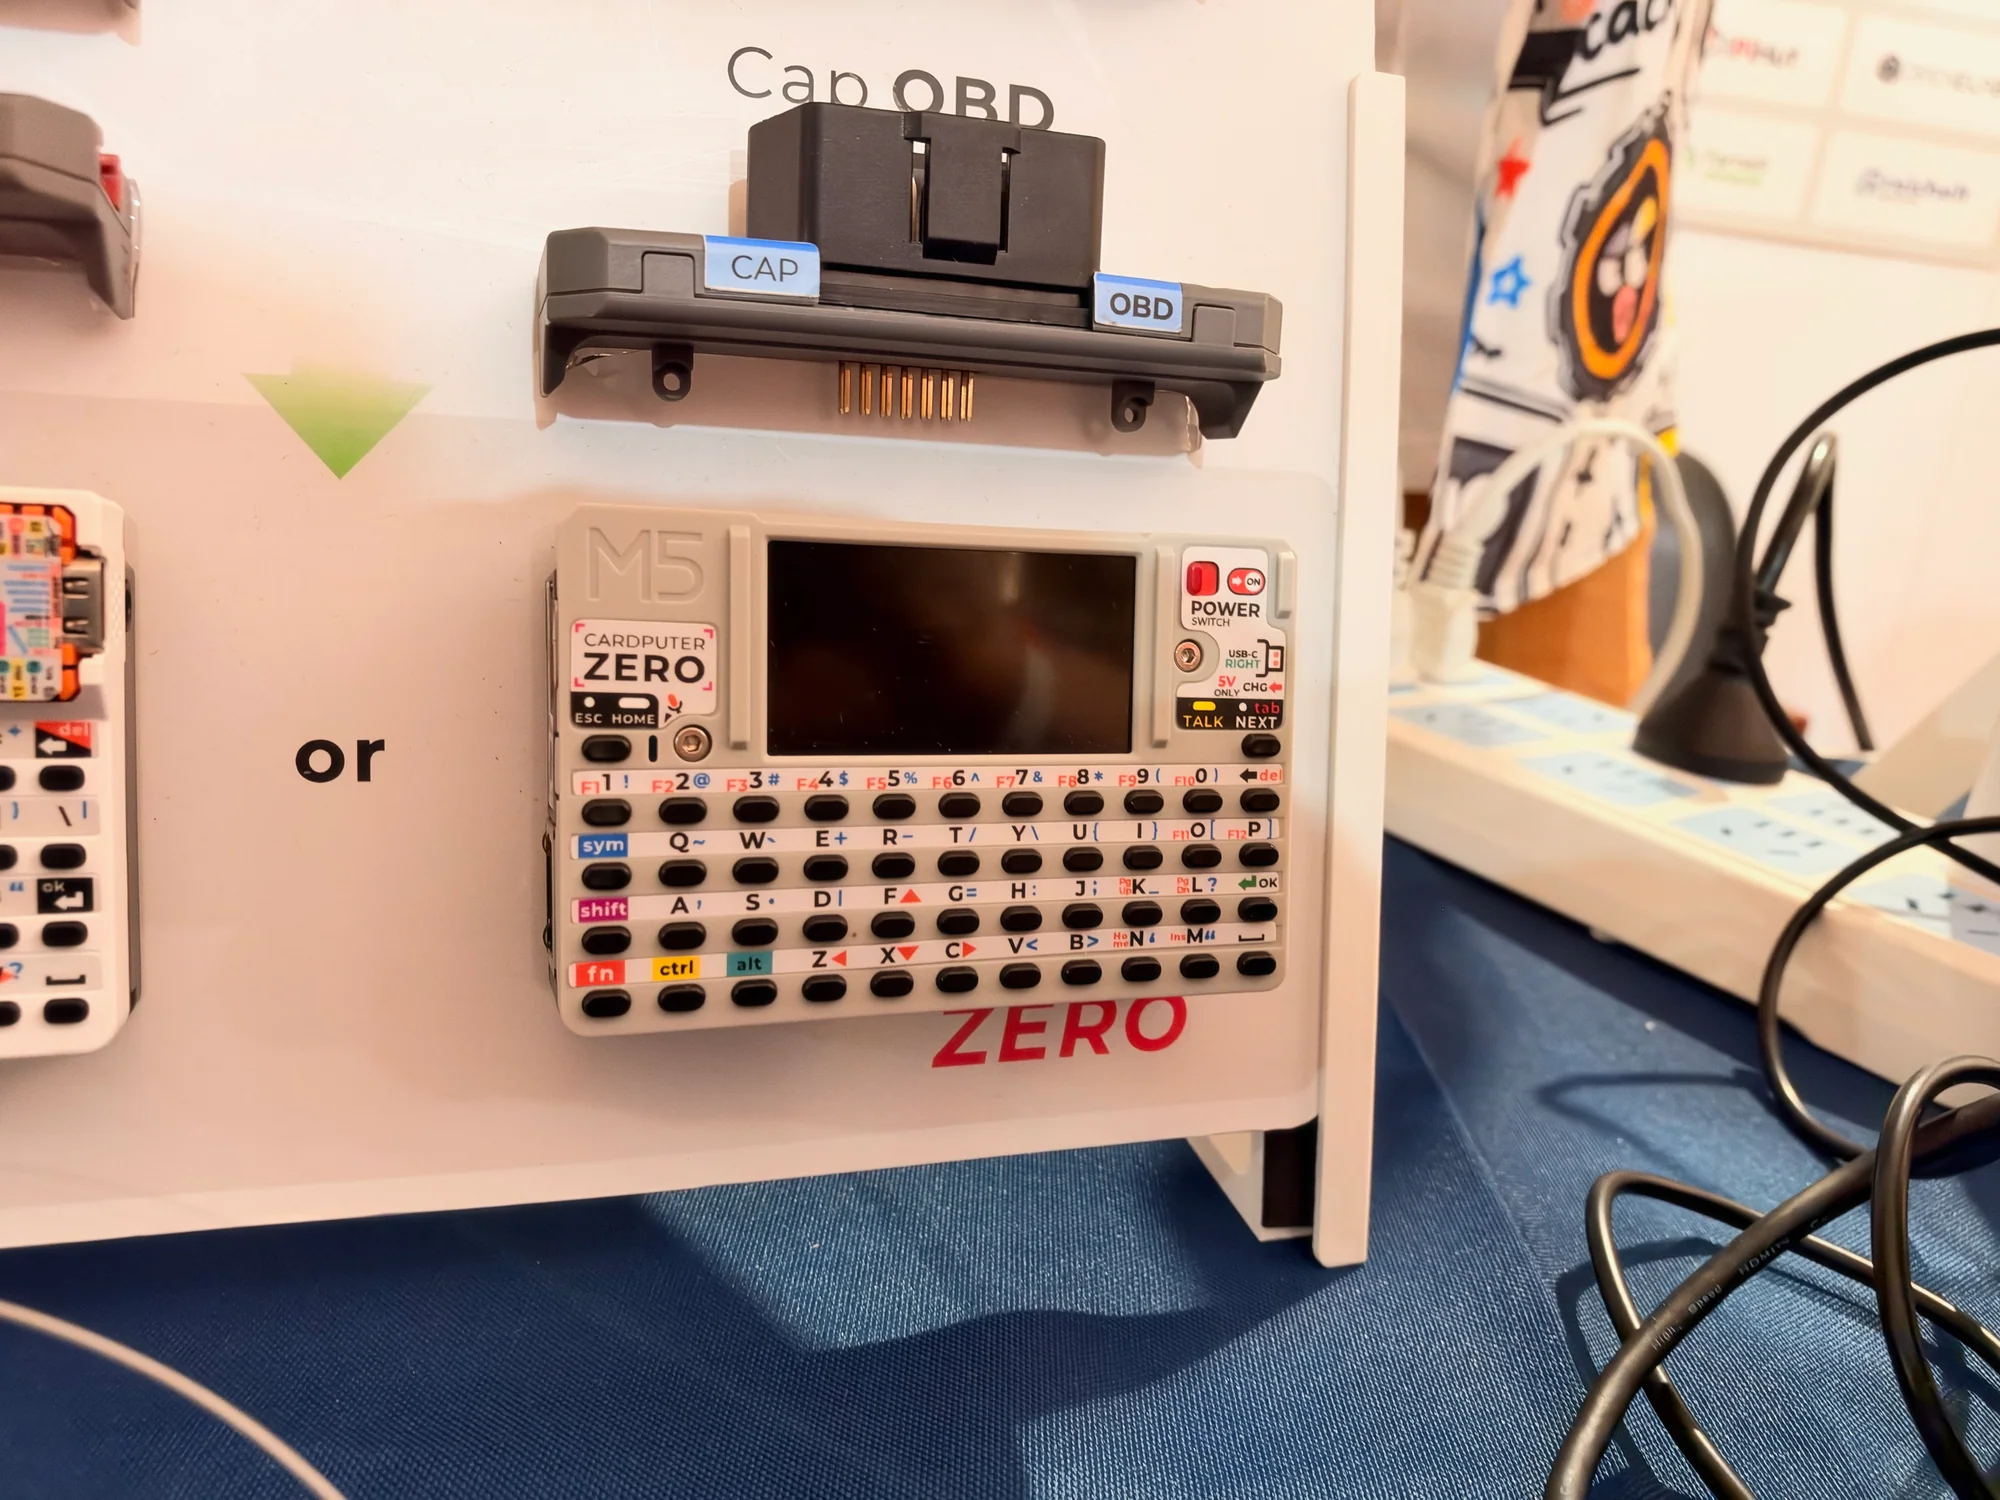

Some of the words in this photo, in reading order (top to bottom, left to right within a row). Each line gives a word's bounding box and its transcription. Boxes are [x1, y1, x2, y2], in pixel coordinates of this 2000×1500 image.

[727, 46, 868, 107] Cap
[893, 69, 1054, 131] OBD
[730, 255, 799, 283] CAP
[1109, 292, 1174, 321] OBD
[588, 527, 704, 604] M5
[1247, 577, 1260, 586] ON
[1191, 601, 1260, 617] POWER
[1192, 617, 1230, 626] SWITCH
[584, 633, 705, 650] CARDPUTER
[1228, 650, 1258, 658] USB-C
[584, 652, 705, 683] ZERO
[1226, 659, 1261, 669] RIGHT
[1218, 676, 1236, 687] 5V
[1243, 682, 1268, 692] CHG
[1214, 689, 1240, 697] ONLY
[1255, 702, 1280, 714] tab
[575, 713, 603, 723] ESC
[612, 713, 656, 725] HOME
[1183, 715, 1224, 728] TALK
[1235, 716, 1278, 728] NEXT
[295, 738, 385, 783] or
[1260, 769, 1282, 781] del
[582, 839, 624, 855] sym
[670, 832, 690, 853] Q
[739, 832, 766, 849] W
[816, 830, 829, 847] E
[883, 829, 897, 845] R
[949, 827, 962, 843] T
[1011, 825, 1026, 841] Y
[1073, 824, 1087, 840] U
[1248, 821, 1261, 836] P
[580, 902, 627, 918] shift
[670, 897, 690, 914] A
[746, 894, 760, 911] S
[814, 890, 831, 907] D
[884, 888, 897, 904] F
[948, 885, 964, 901] G
[1011, 883, 1026, 899] H
[1075, 880, 1086, 896] J
[1132, 878, 1146, 894] K
[1192, 877, 1202, 892] L
[1259, 878, 1278, 888] OK
[587, 965, 614, 982] fn
[660, 960, 694, 976] ctrl
[737, 957, 762, 971] alt
[812, 950, 827, 968] Z
[880, 946, 896, 964] X
[945, 942, 960, 958] C
[1008, 938, 1024, 954] V
[1070, 934, 1084, 950] B
[1130, 930, 1144, 946] N
[1187, 928, 1203, 944] M
[932, 996, 1187, 1068] ZERO
